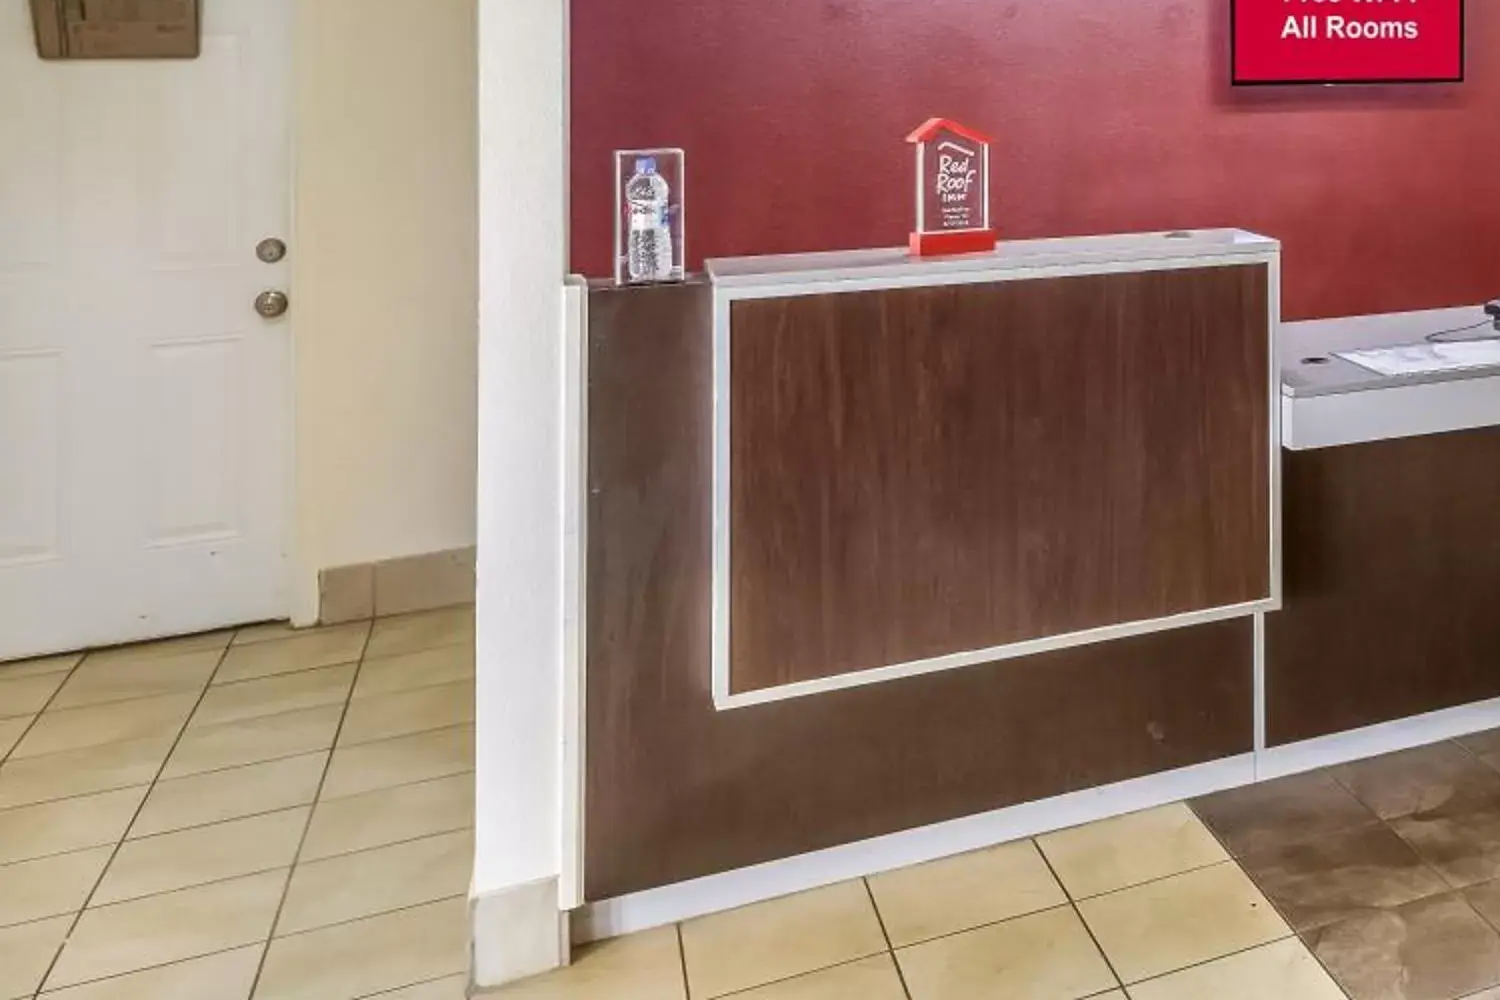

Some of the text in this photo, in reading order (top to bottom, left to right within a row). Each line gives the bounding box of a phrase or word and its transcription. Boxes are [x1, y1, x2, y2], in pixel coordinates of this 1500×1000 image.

[1281, 16, 1418, 39] All Rooms
[940, 155, 969, 175] Red
[937, 169, 977, 194] Roof
